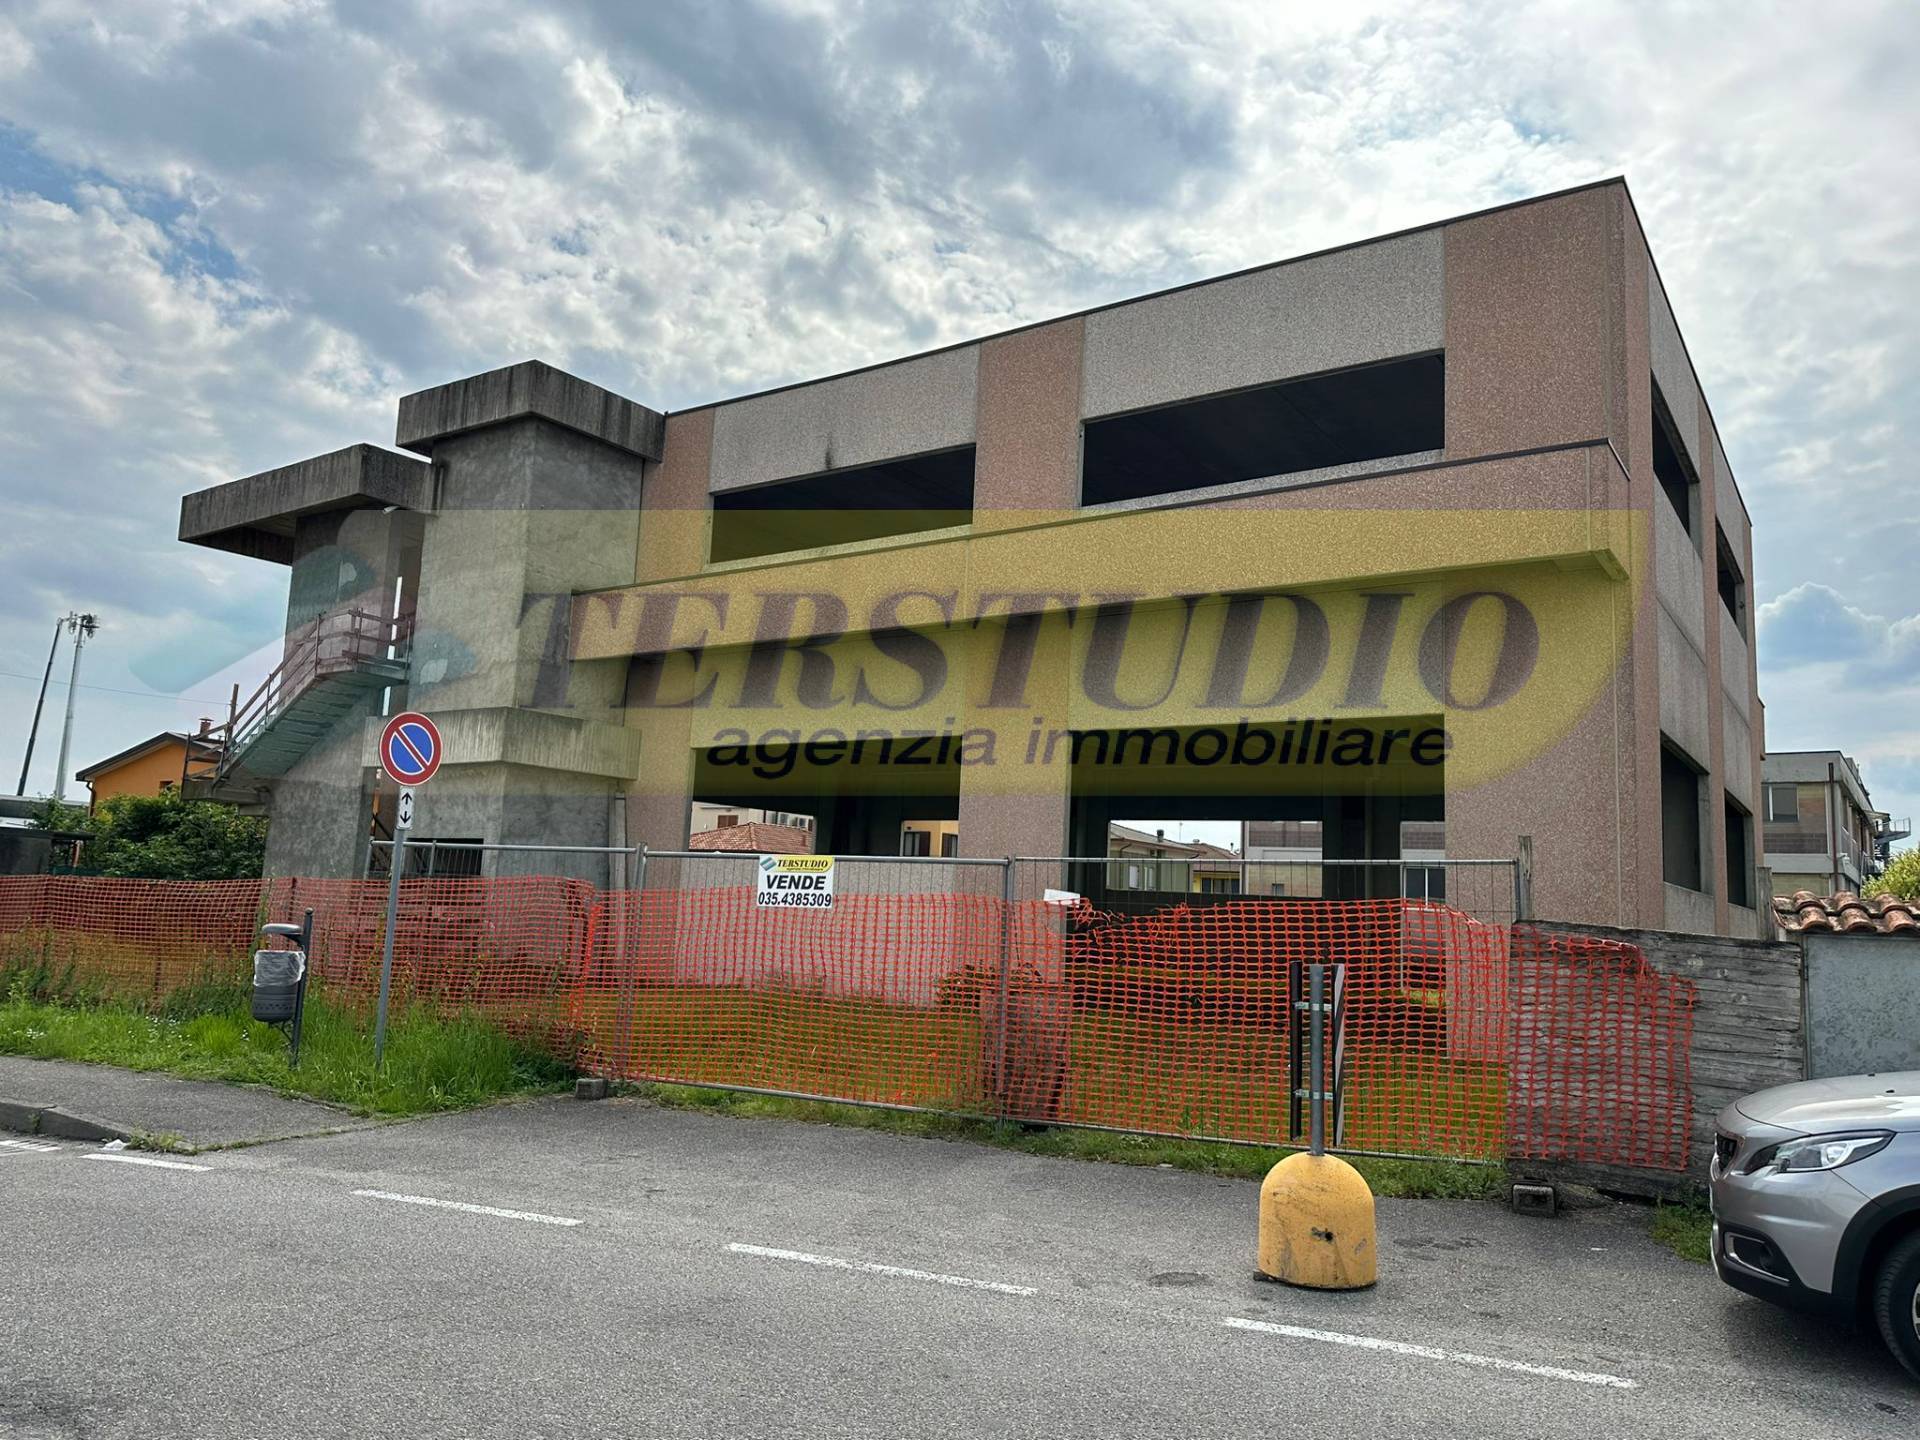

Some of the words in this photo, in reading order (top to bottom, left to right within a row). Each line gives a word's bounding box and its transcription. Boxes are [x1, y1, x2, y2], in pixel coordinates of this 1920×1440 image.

[777, 859, 828, 868] TERSTUDIO
[767, 875, 826, 890] VENDE
[758, 892, 832, 907] 035.4385309
